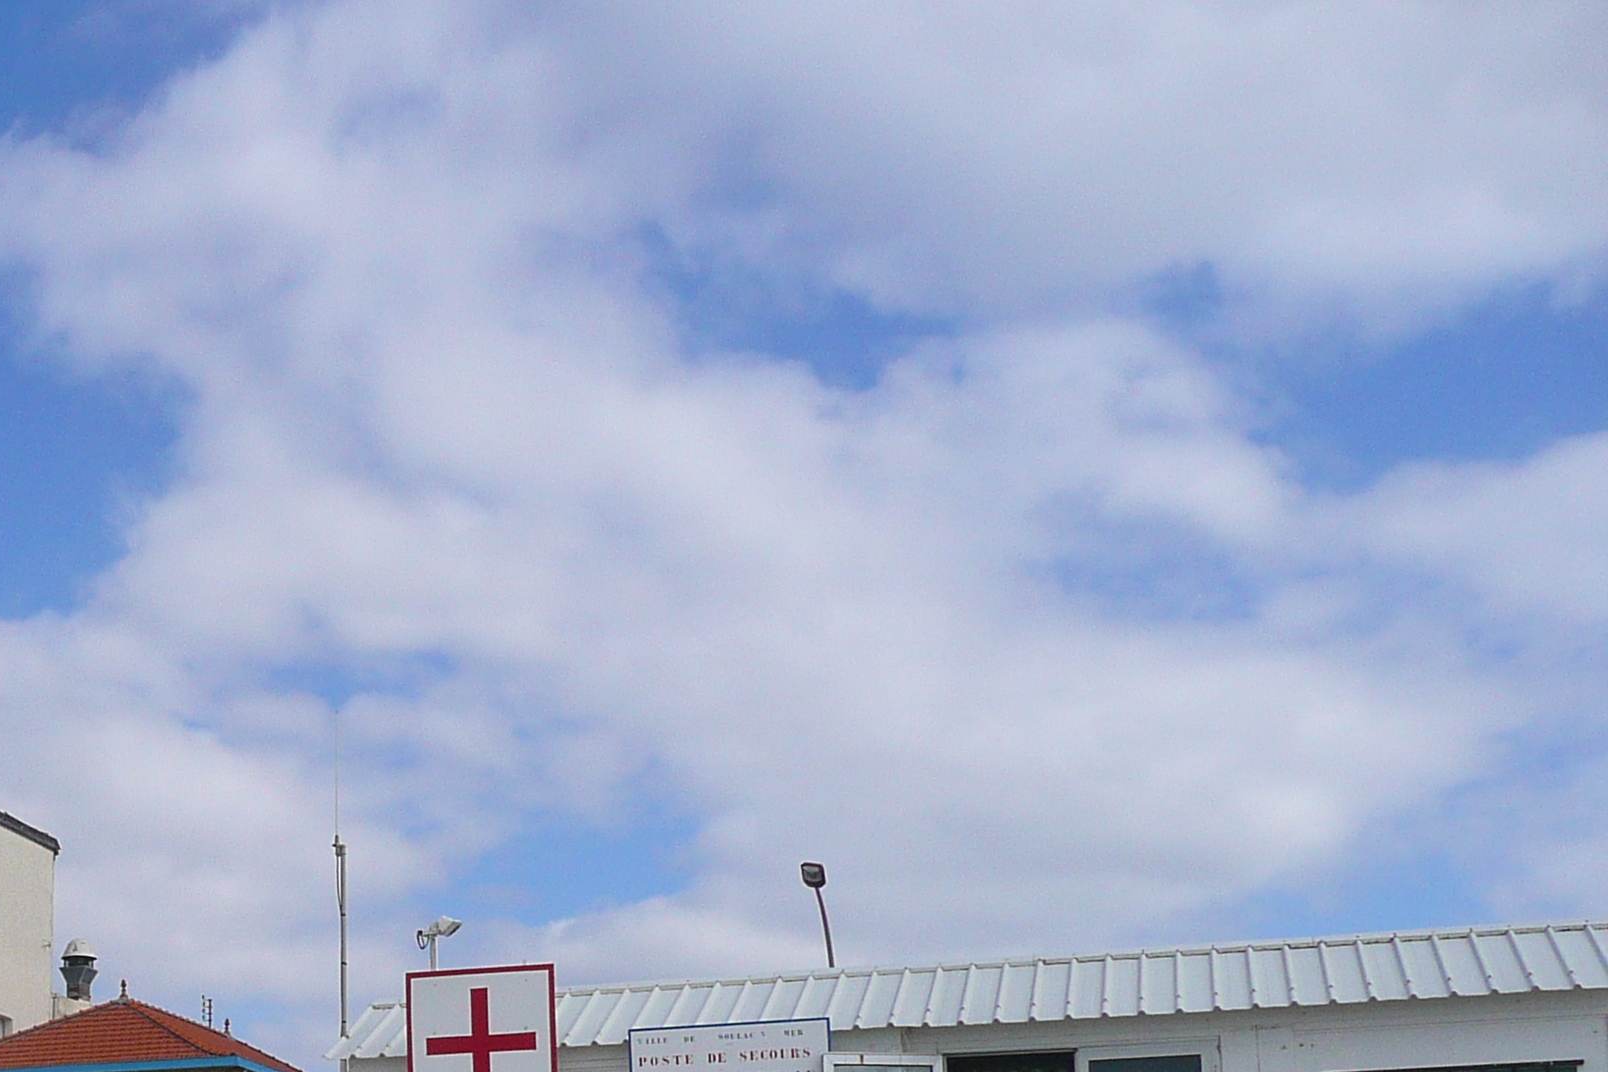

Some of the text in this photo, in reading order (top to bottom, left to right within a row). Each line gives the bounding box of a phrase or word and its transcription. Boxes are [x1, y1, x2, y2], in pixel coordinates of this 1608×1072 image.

[638, 1047, 811, 1067] POSTE DE SECOURS
